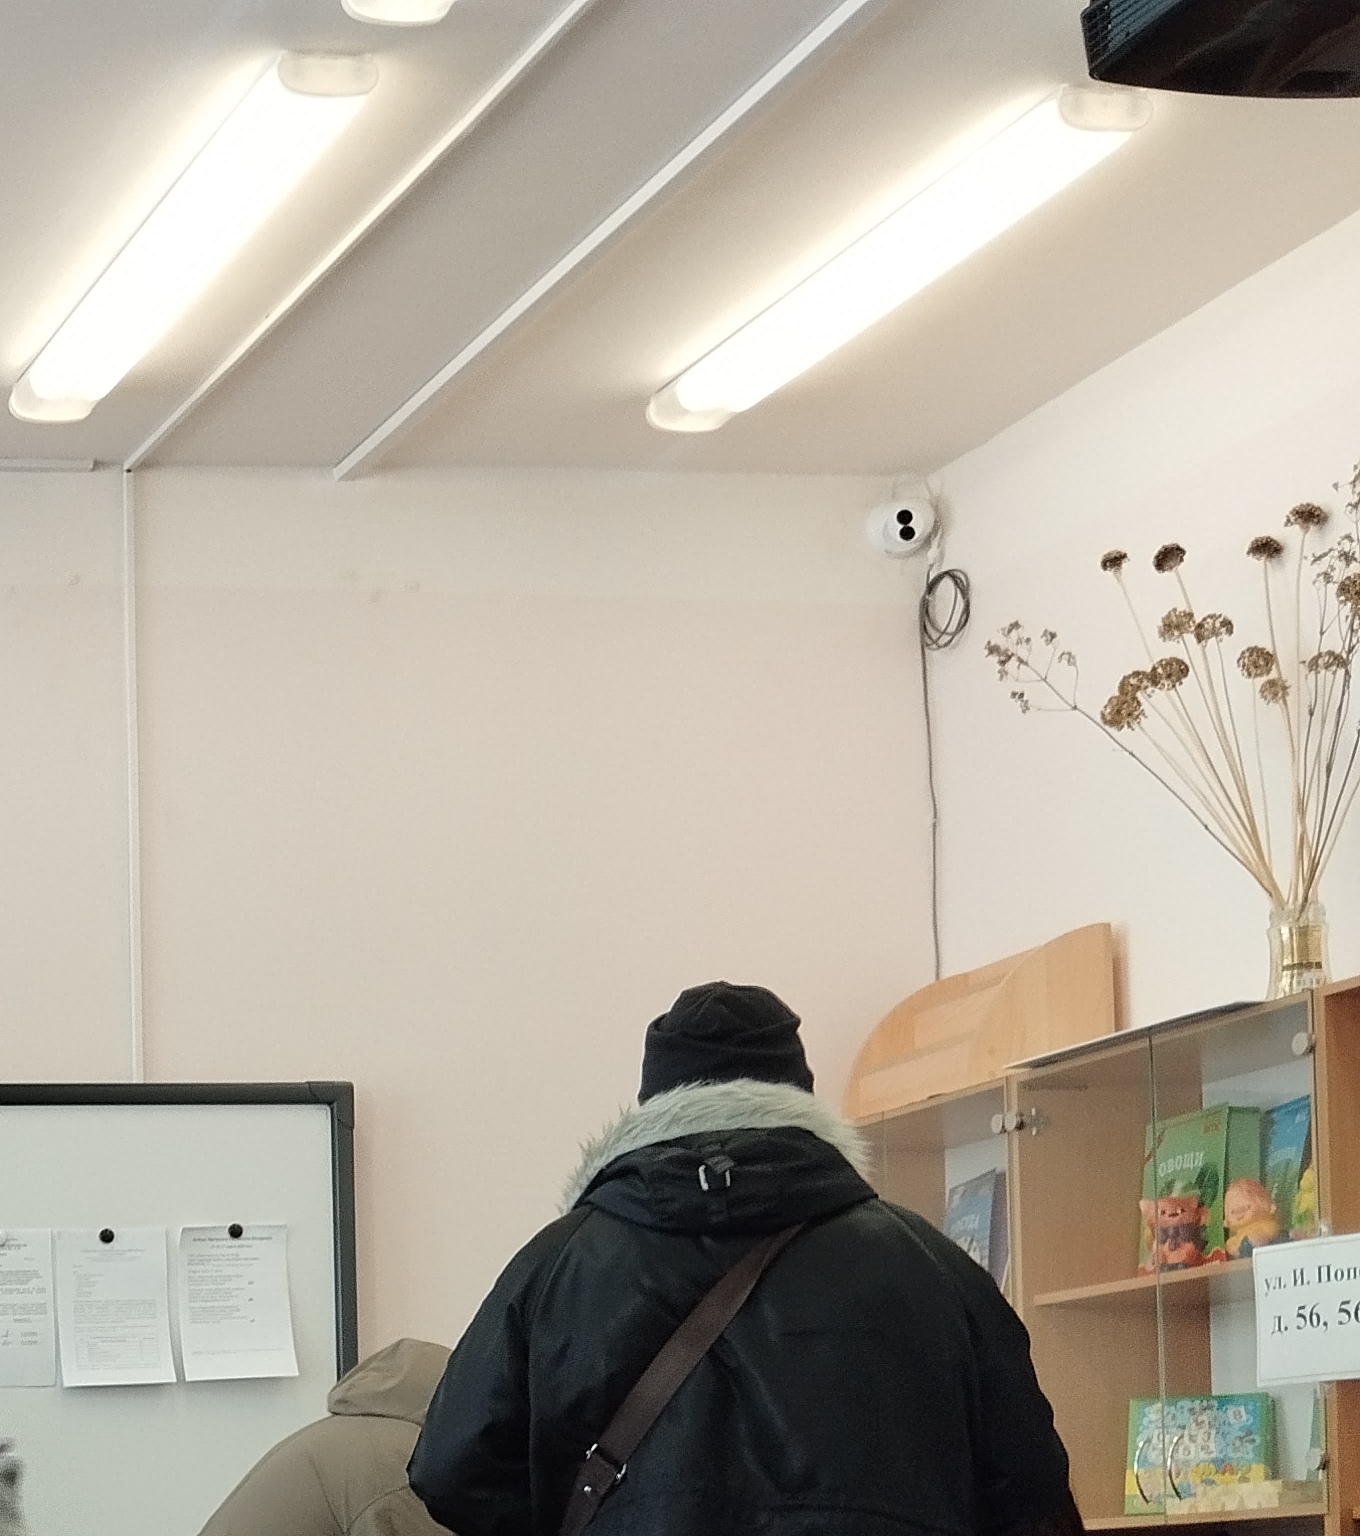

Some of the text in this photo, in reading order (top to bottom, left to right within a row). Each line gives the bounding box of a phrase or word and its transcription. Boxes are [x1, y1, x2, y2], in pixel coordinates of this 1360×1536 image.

[1158, 1150, 1205, 1177] ОВОЩИ
[1265, 1264, 1360, 1297] ул. И. Поп
[1271, 1315, 1289, 1337] д.
[1296, 1302, 1328, 1333] 56,
